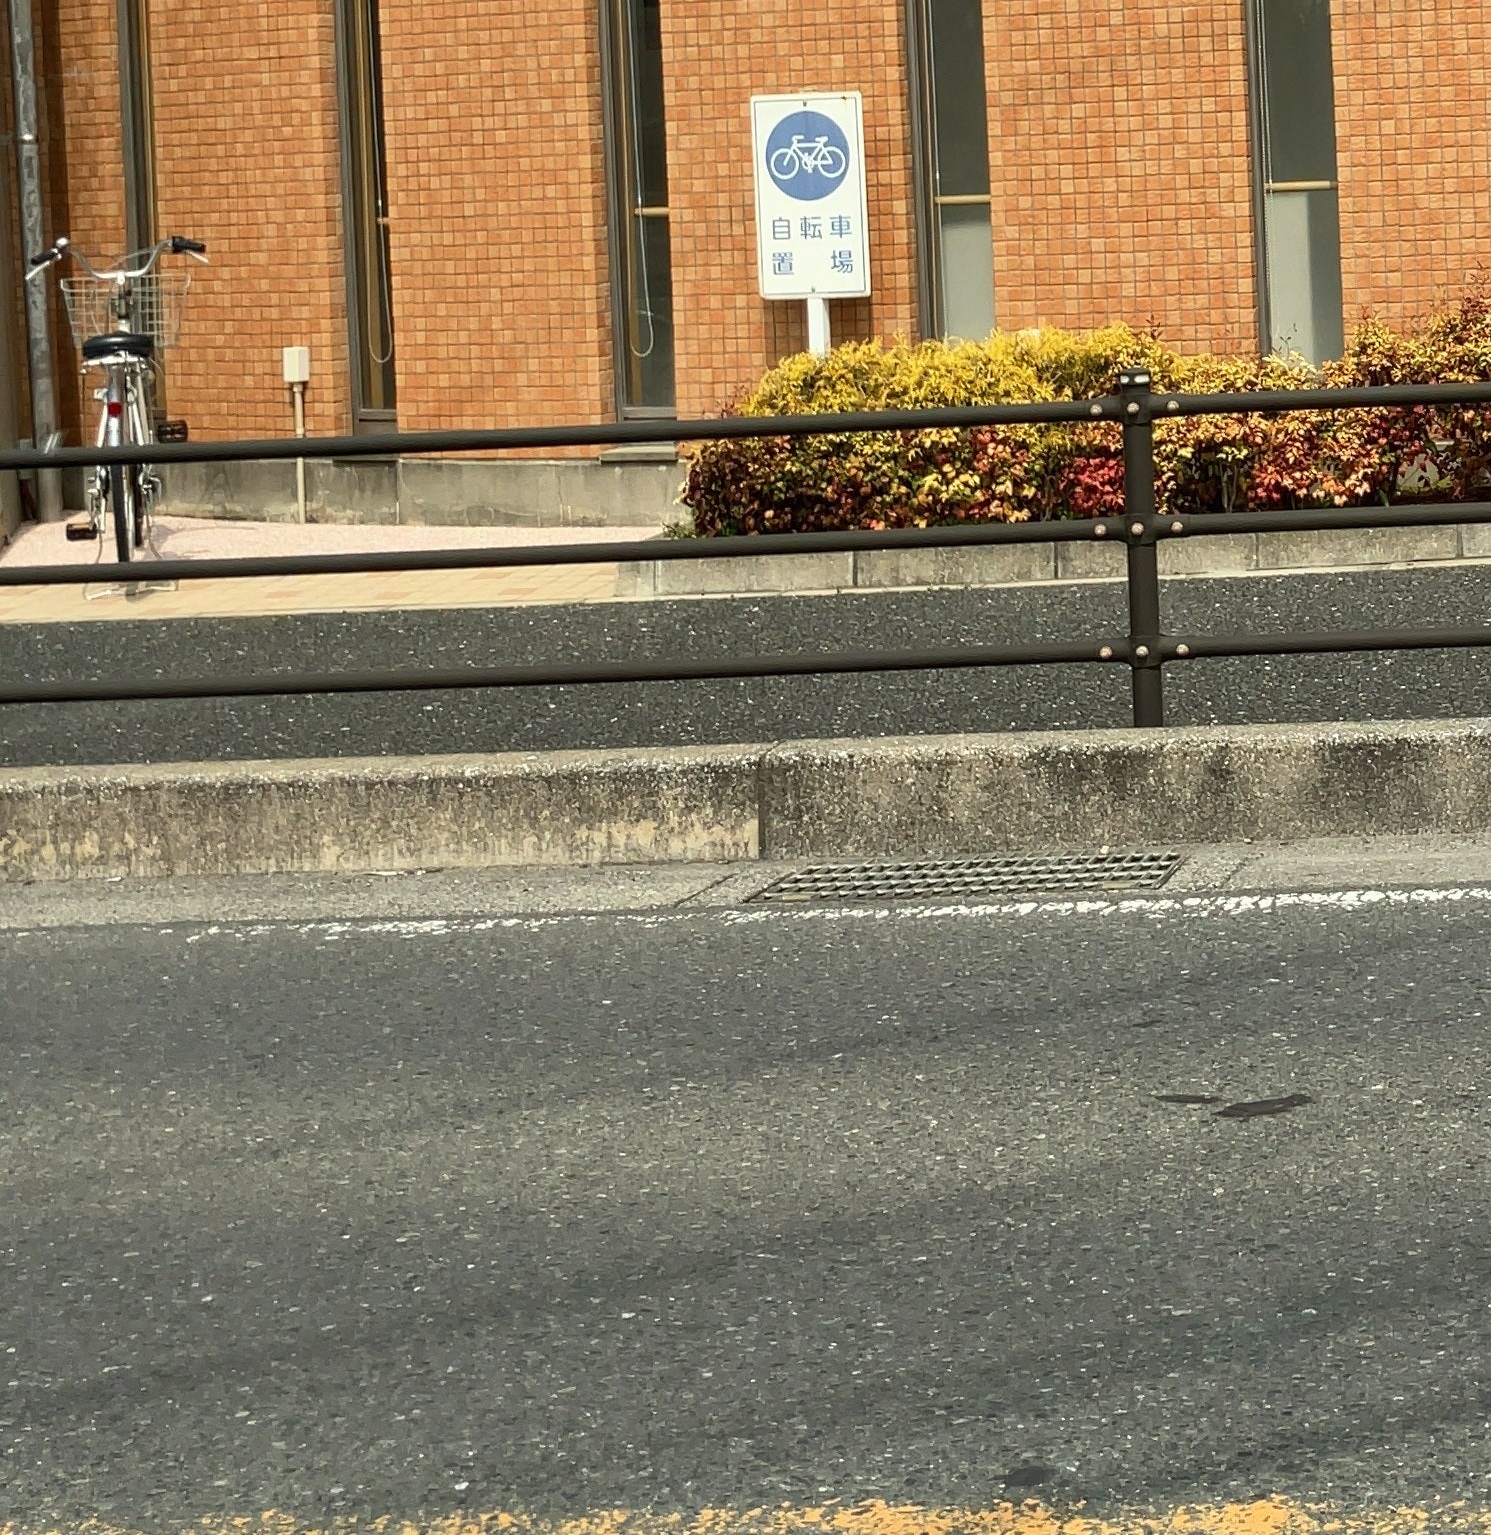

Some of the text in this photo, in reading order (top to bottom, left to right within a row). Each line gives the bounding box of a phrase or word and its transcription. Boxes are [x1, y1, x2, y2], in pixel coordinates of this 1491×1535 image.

[772, 215, 852, 240] 自転車
[772, 250, 853, 275] 置場
